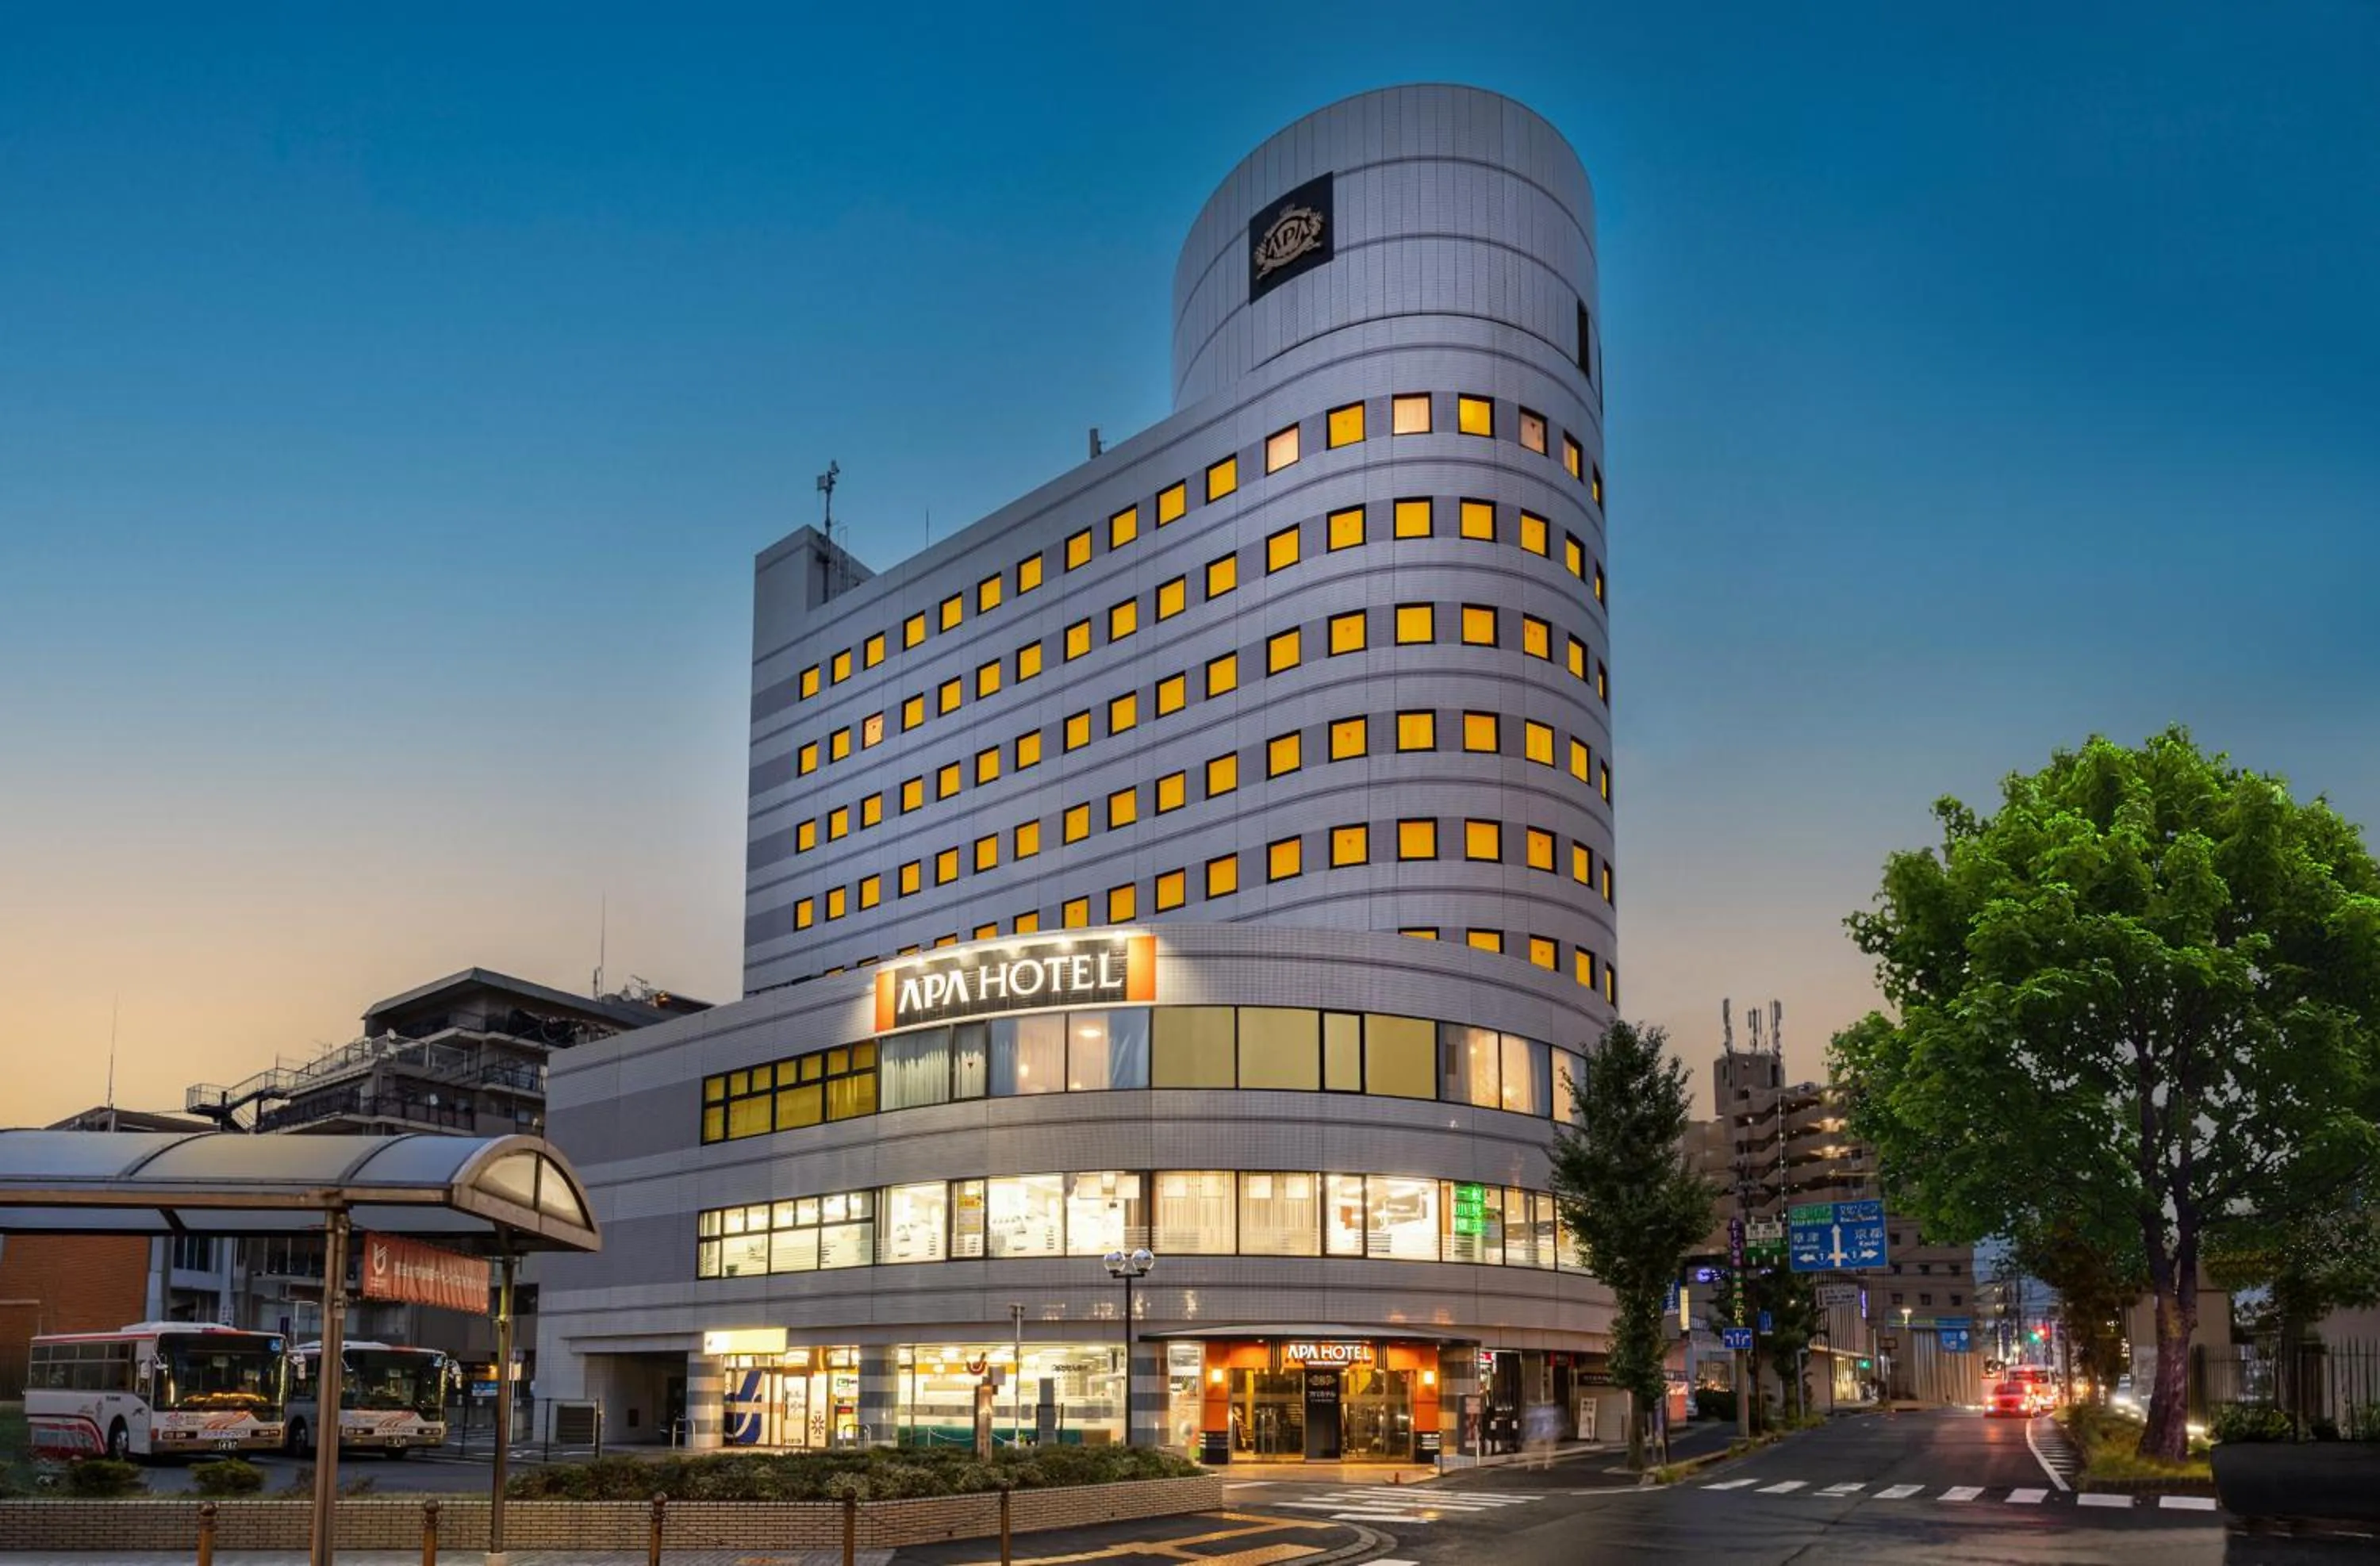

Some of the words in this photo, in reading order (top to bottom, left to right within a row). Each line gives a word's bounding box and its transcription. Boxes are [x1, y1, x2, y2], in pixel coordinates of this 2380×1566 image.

[897, 969, 970, 1015] APA
[978, 950, 1123, 1000] HOTEL
[1288, 1345, 1319, 1359] APA
[1321, 1345, 1372, 1360] HOTEL
